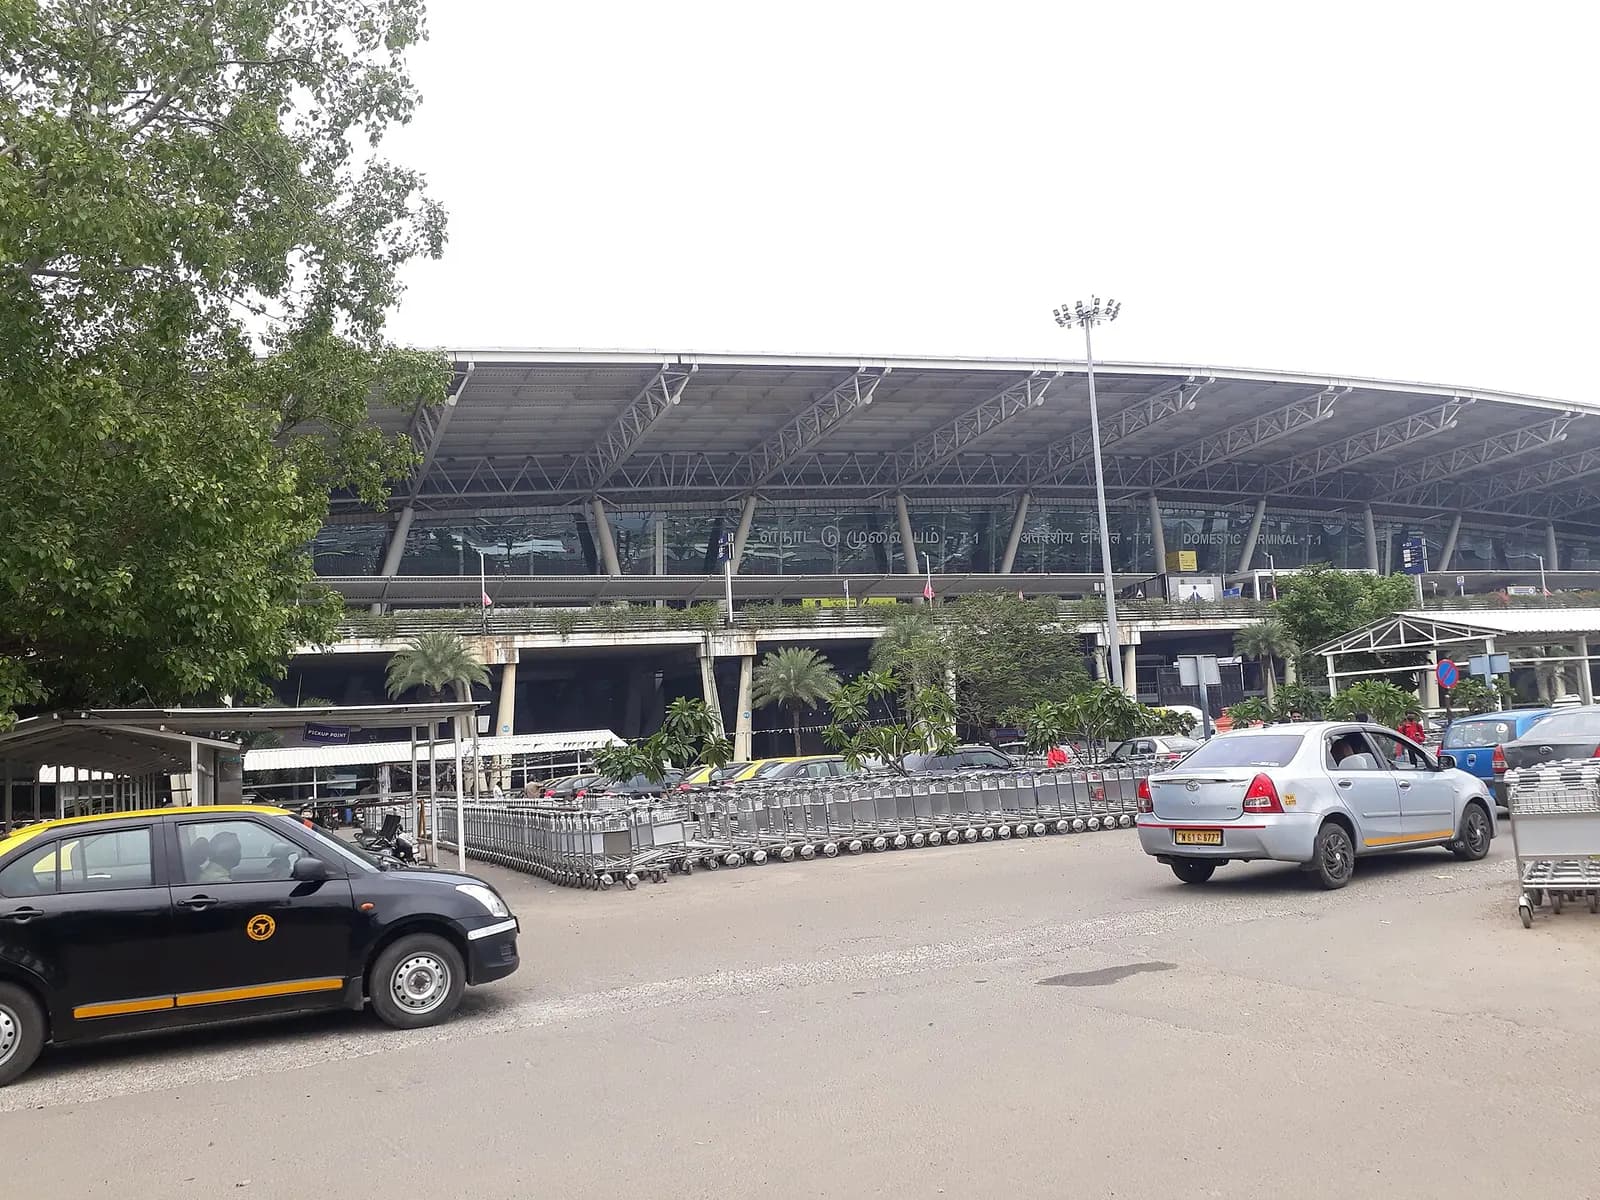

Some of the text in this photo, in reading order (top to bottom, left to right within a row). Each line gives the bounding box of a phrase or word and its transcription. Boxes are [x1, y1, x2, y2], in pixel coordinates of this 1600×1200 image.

[1183, 533, 1241, 545] DOMESTIC
[1244, 533, 1299, 545] RMINAL
[308, 729, 329, 737] PICKUP
